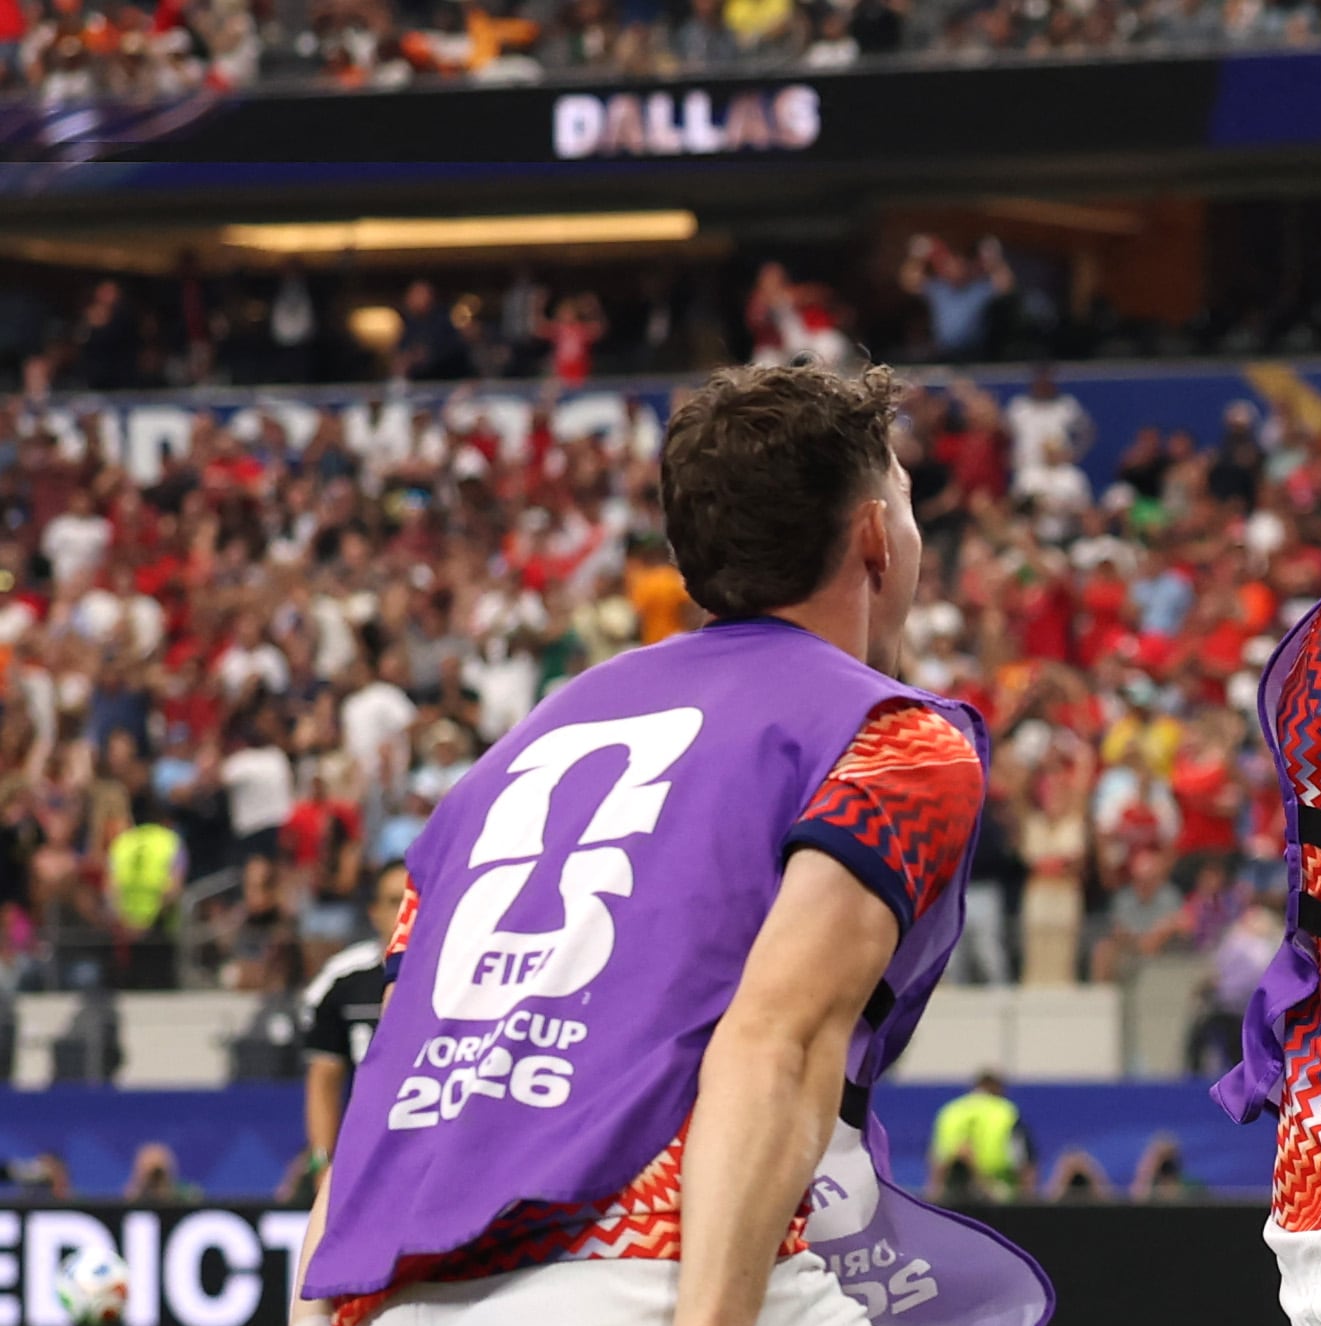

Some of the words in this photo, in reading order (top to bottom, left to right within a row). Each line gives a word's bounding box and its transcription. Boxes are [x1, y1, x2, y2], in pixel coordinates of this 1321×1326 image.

[554, 86, 819, 158] DALLAS
[472, 948, 555, 986] FIF
[504, 1010, 588, 1050] CUP
